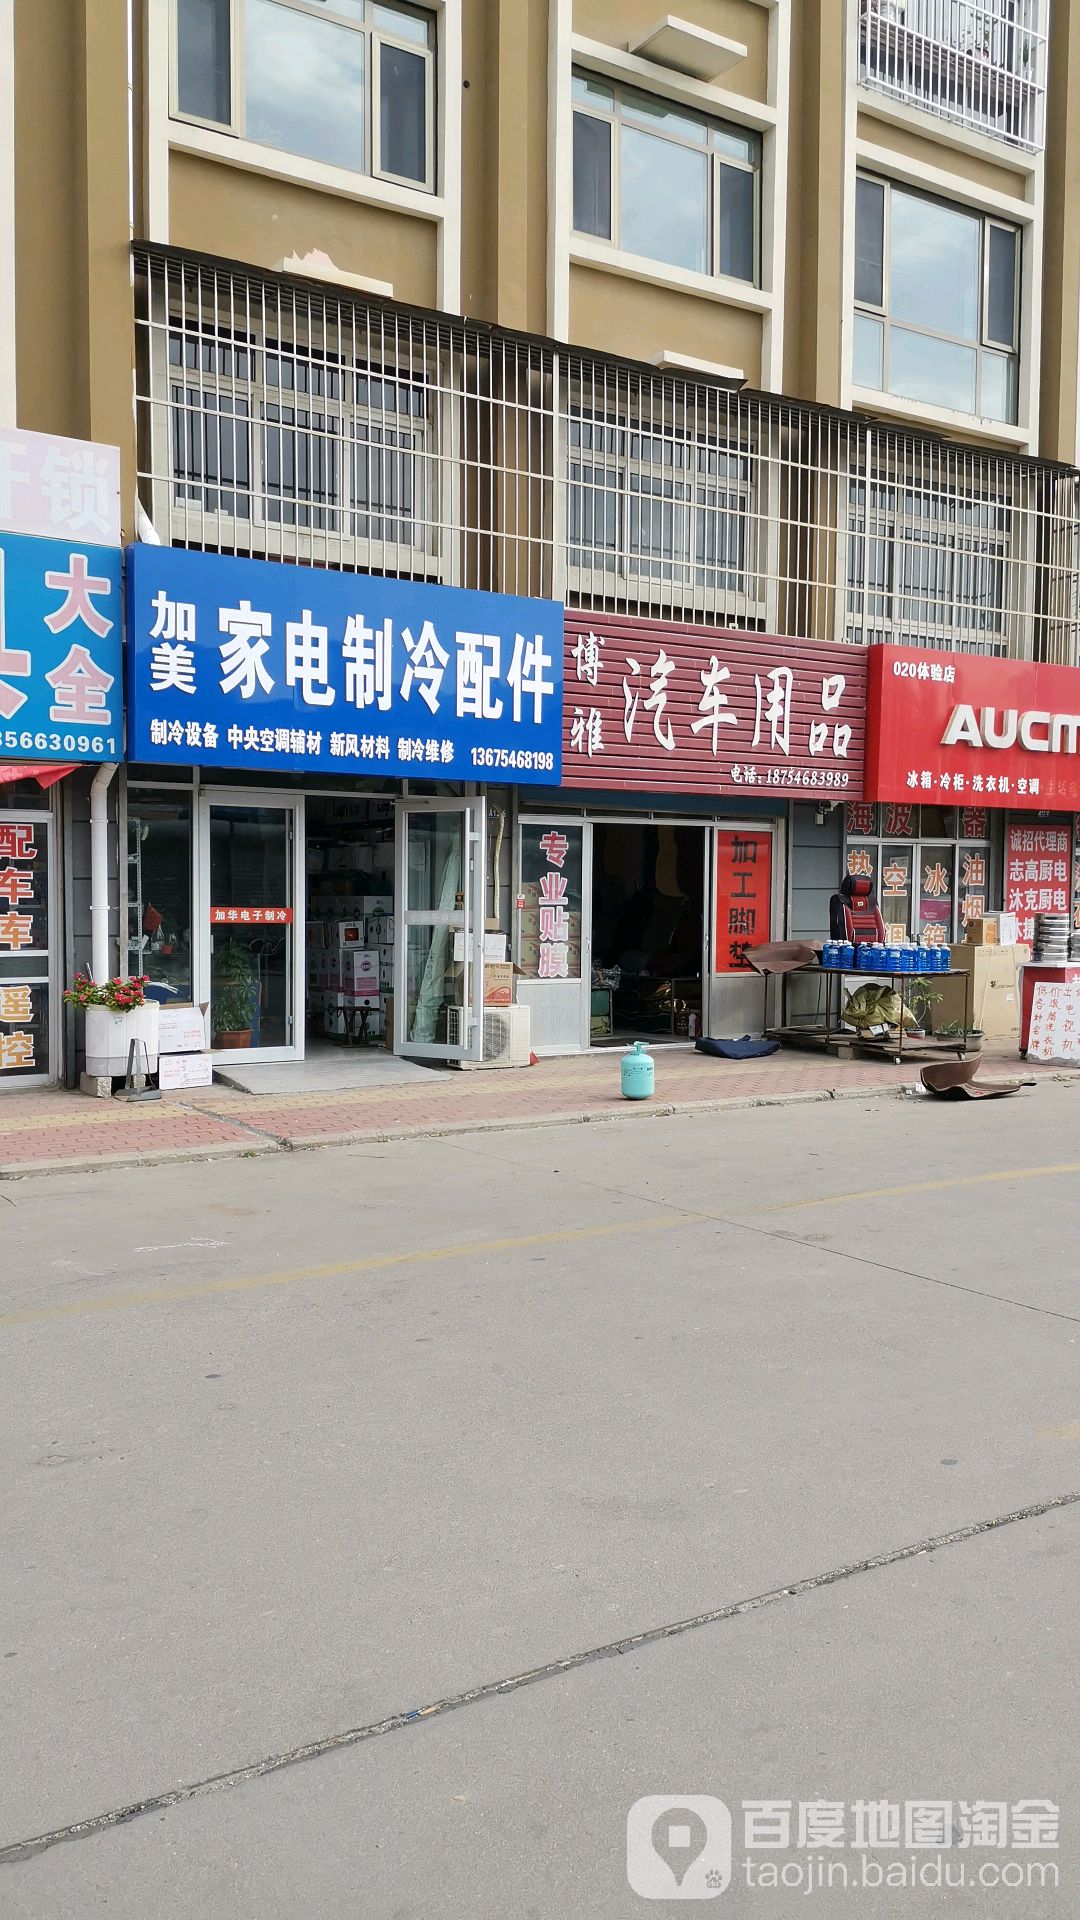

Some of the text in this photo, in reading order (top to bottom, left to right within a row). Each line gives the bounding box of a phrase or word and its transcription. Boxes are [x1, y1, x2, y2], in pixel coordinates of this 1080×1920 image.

[43, 553, 114, 726] 大全
[149, 590, 197, 695] 加美
[218, 600, 554, 724] 家电制冷配件
[570, 631, 605, 758] 博雅
[622, 649, 852, 758] 汽车用品
[0, 731, 116, 754] 56630961
[150, 719, 554, 770] 制冷设备 中央空调辅材 新风材料 制冷维修 13675468198
[1009, 859, 1068, 882] 志高厨电
[1010, 829, 1068, 853] 诚招代理商
[215, 909, 287, 921] 加华电子制冷
[539, 831, 569, 978] 专业贴膜
[1008, 887, 1067, 911] 沐克厨电
